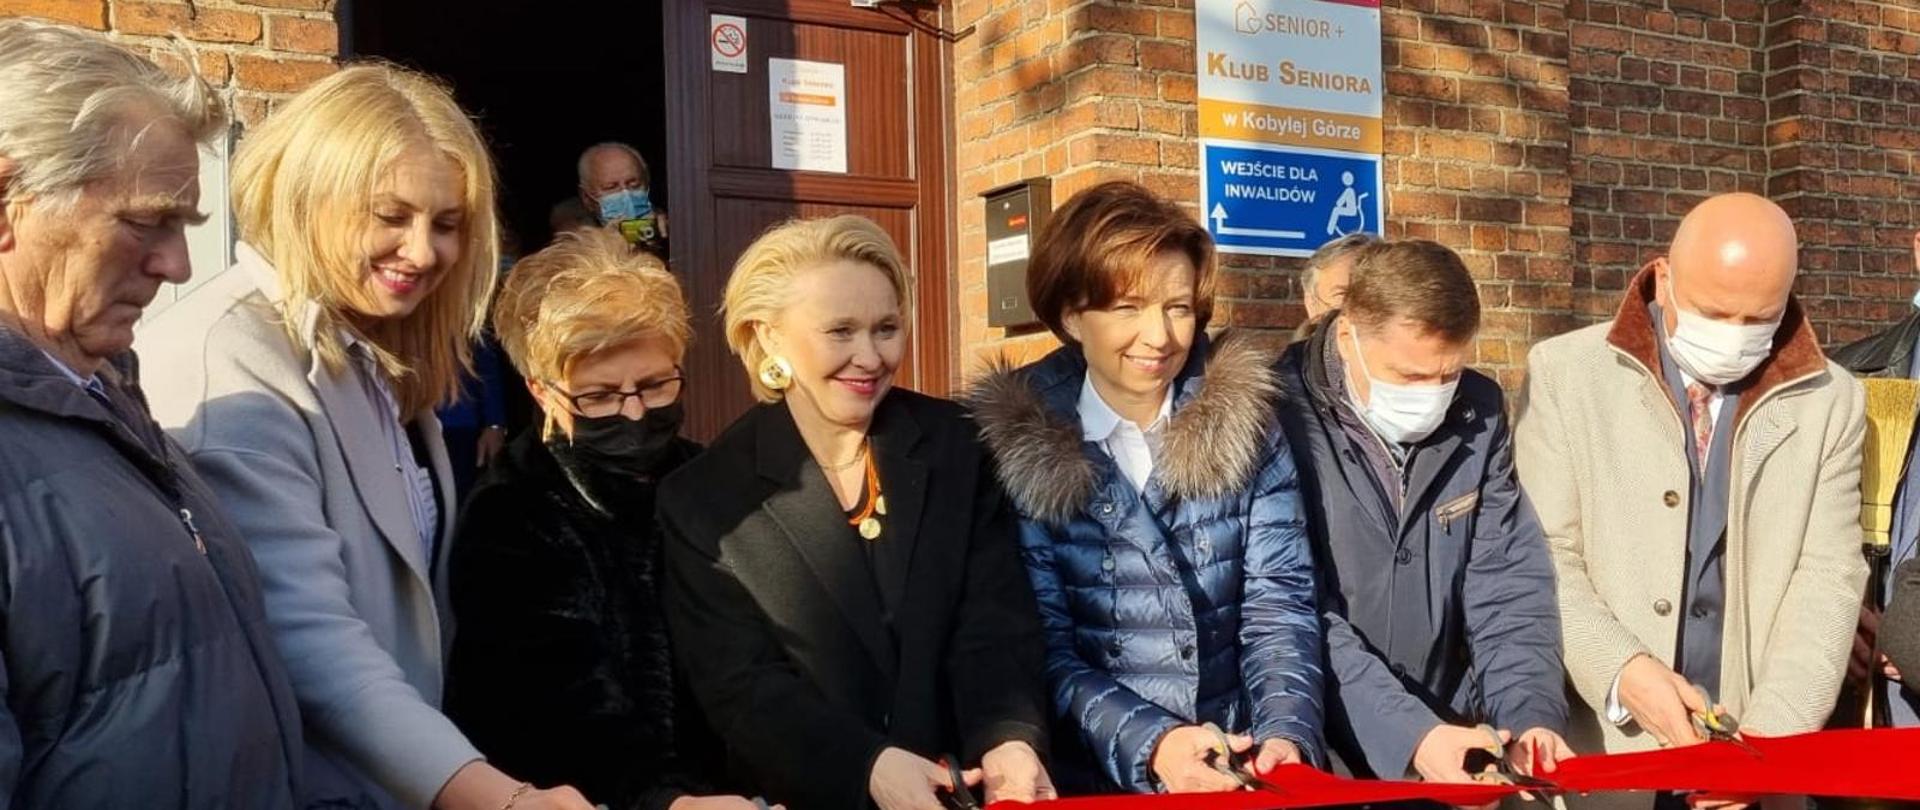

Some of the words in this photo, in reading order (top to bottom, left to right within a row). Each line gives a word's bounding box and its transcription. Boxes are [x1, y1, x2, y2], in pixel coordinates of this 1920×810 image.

[1265, 14, 1330, 38] SENIOR
[1207, 52, 1270, 82] KLUB
[1279, 61, 1371, 94] SENIORA
[1223, 113, 1237, 127] w
[1243, 112, 1306, 138] Kobylej
[1313, 119, 1360, 140] Górze
[1221, 160, 1285, 179] WEJŚCIE
[1289, 167, 1318, 182] DLA
[1225, 184, 1315, 203] INWALIDÓW
